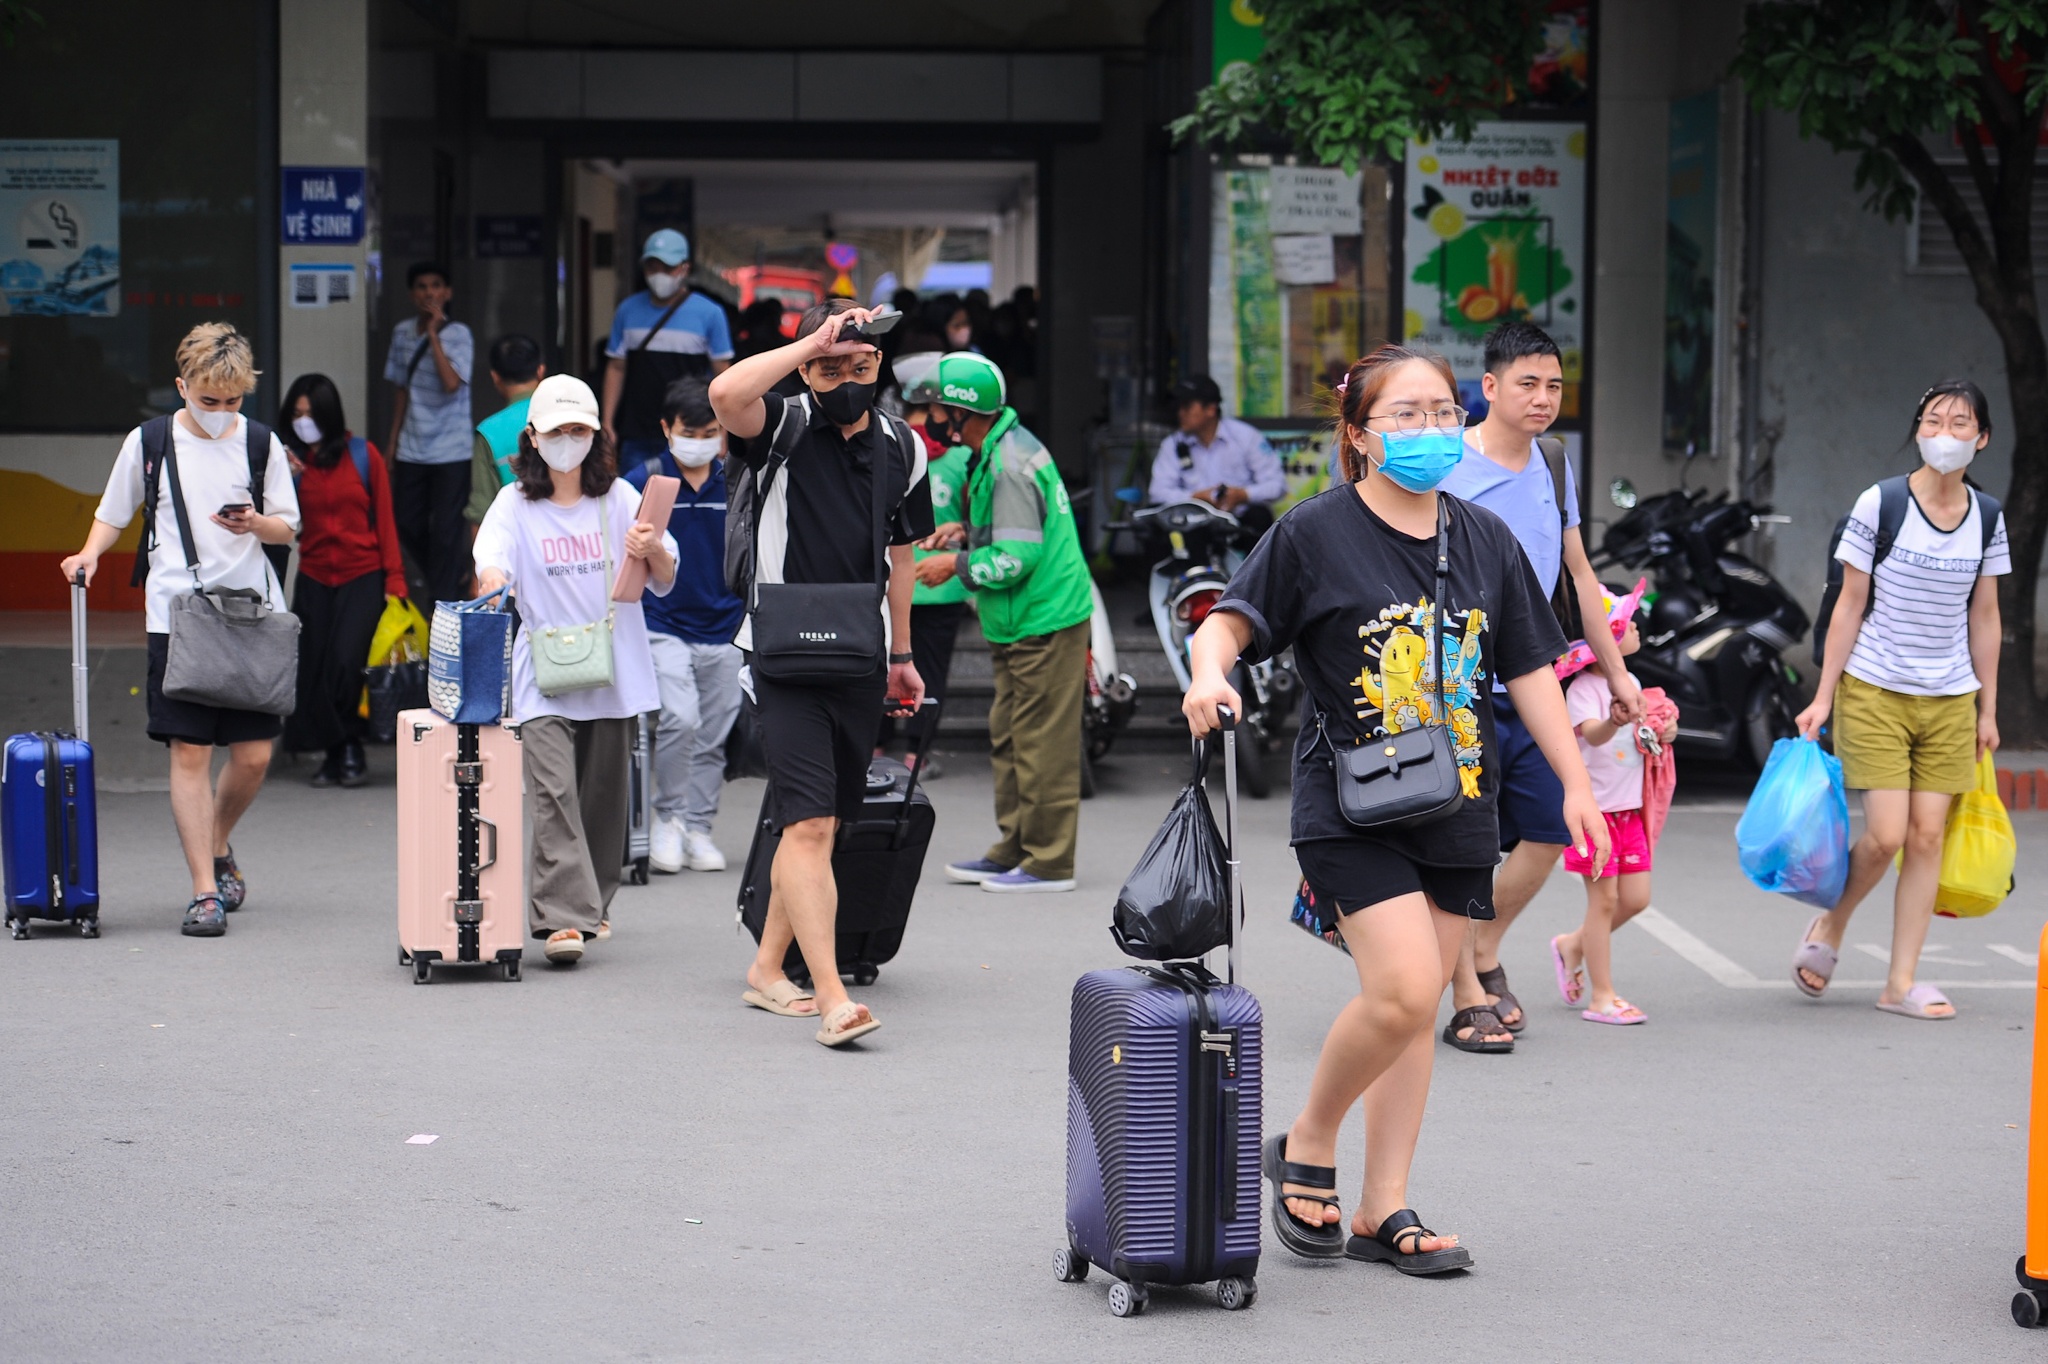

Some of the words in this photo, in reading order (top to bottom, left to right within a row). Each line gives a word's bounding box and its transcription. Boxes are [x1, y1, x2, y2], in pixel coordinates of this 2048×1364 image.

[302, 175, 337, 201] NHÀ
[1442, 164, 1512, 190] NHIỆT
[286, 208, 307, 241] VỆ
[311, 213, 353, 237] SINH
[943, 383, 979, 403] Grab
[542, 531, 603, 564] DONU
[546, 565, 575, 577] WORRY
[577, 563, 588, 575] BE
[590, 560, 614, 574] HAPY
